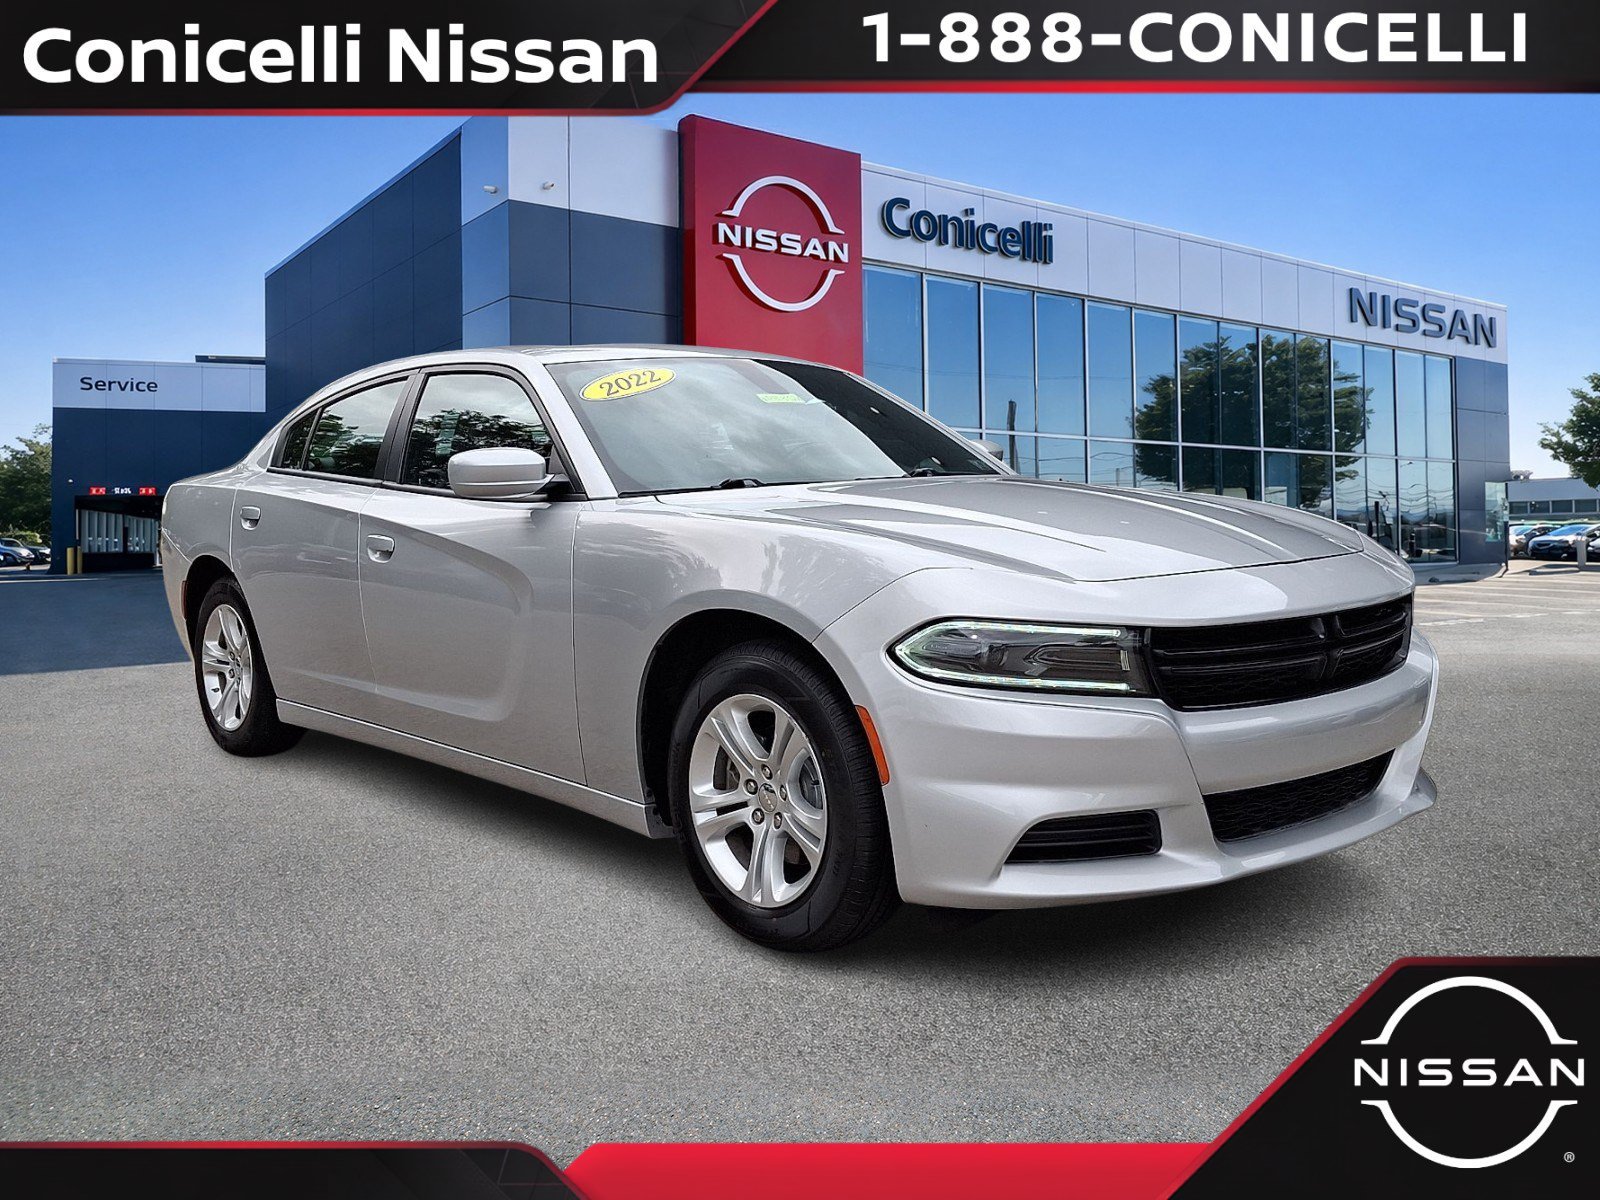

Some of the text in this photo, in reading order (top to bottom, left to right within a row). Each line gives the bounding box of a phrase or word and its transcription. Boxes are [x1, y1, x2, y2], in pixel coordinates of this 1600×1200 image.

[717, 222, 849, 264] NISSAN
[882, 197, 1054, 265] Conicelli
[1348, 287, 1497, 348] NISSAN
[79, 376, 158, 393] Service
[599, 370, 662, 397] 2022
